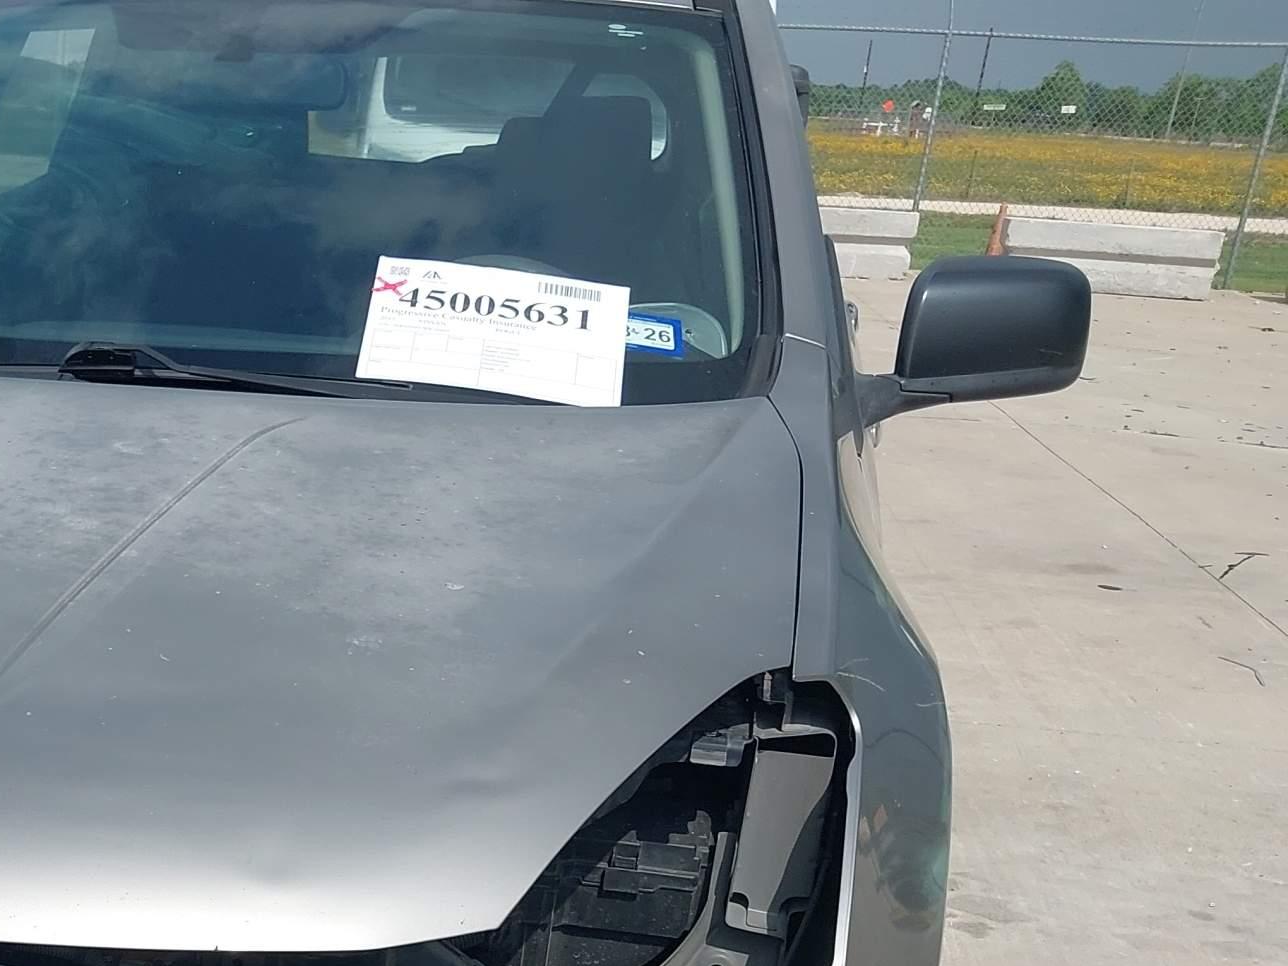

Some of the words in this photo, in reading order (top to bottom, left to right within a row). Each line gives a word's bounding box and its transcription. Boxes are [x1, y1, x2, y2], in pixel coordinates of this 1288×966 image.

[380, 305, 441, 319] Progressive
[442, 311, 487, 325] Casualty
[489, 318, 537, 331] Insurance
[398, 287, 592, 331] 45005631
[643, 327, 671, 343] 26
